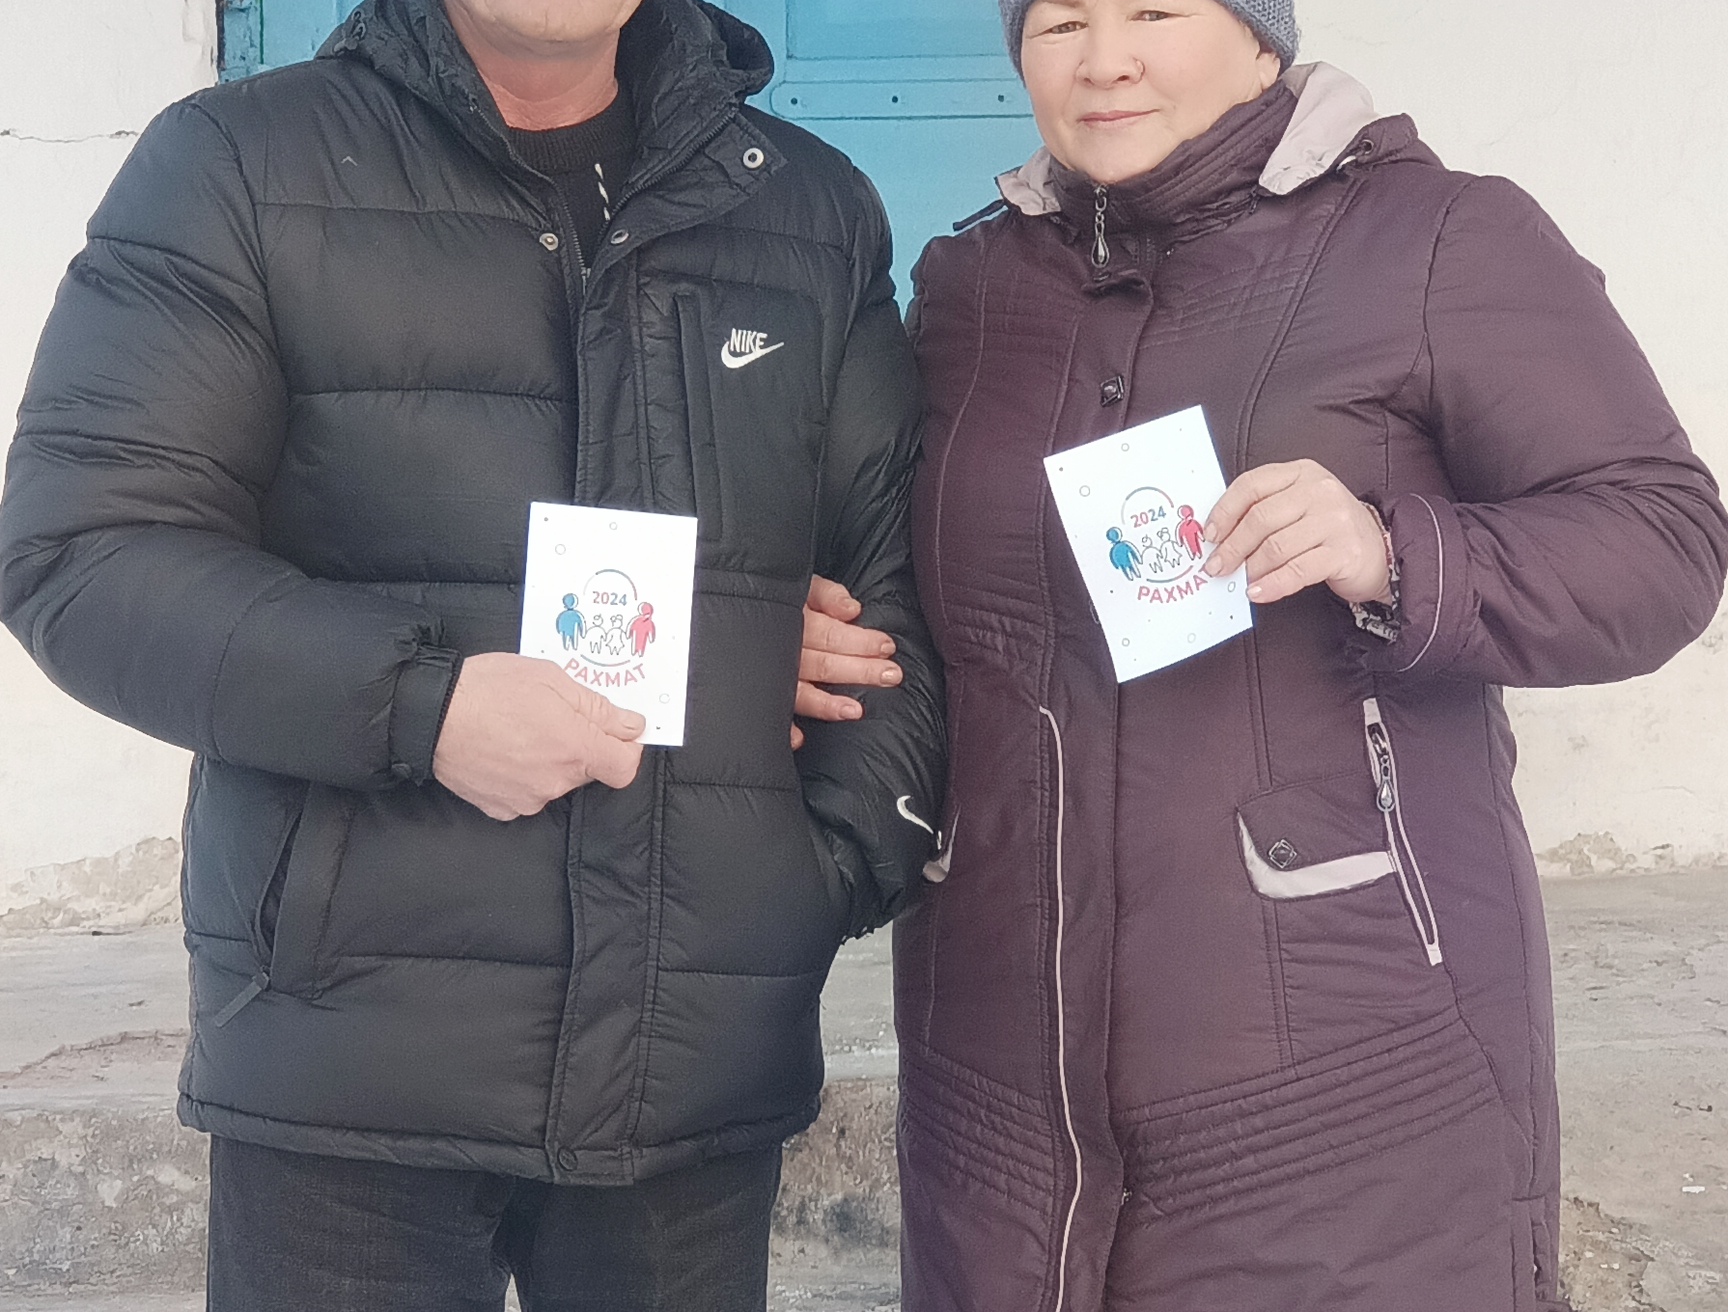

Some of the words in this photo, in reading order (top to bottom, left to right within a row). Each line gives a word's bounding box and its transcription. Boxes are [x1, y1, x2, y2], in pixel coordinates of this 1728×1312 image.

[730, 328, 768, 353] NIKE
[1130, 506, 1167, 528] 2024
[592, 591, 628, 606] 2024
[563, 657, 645, 688] РАХМАТ
